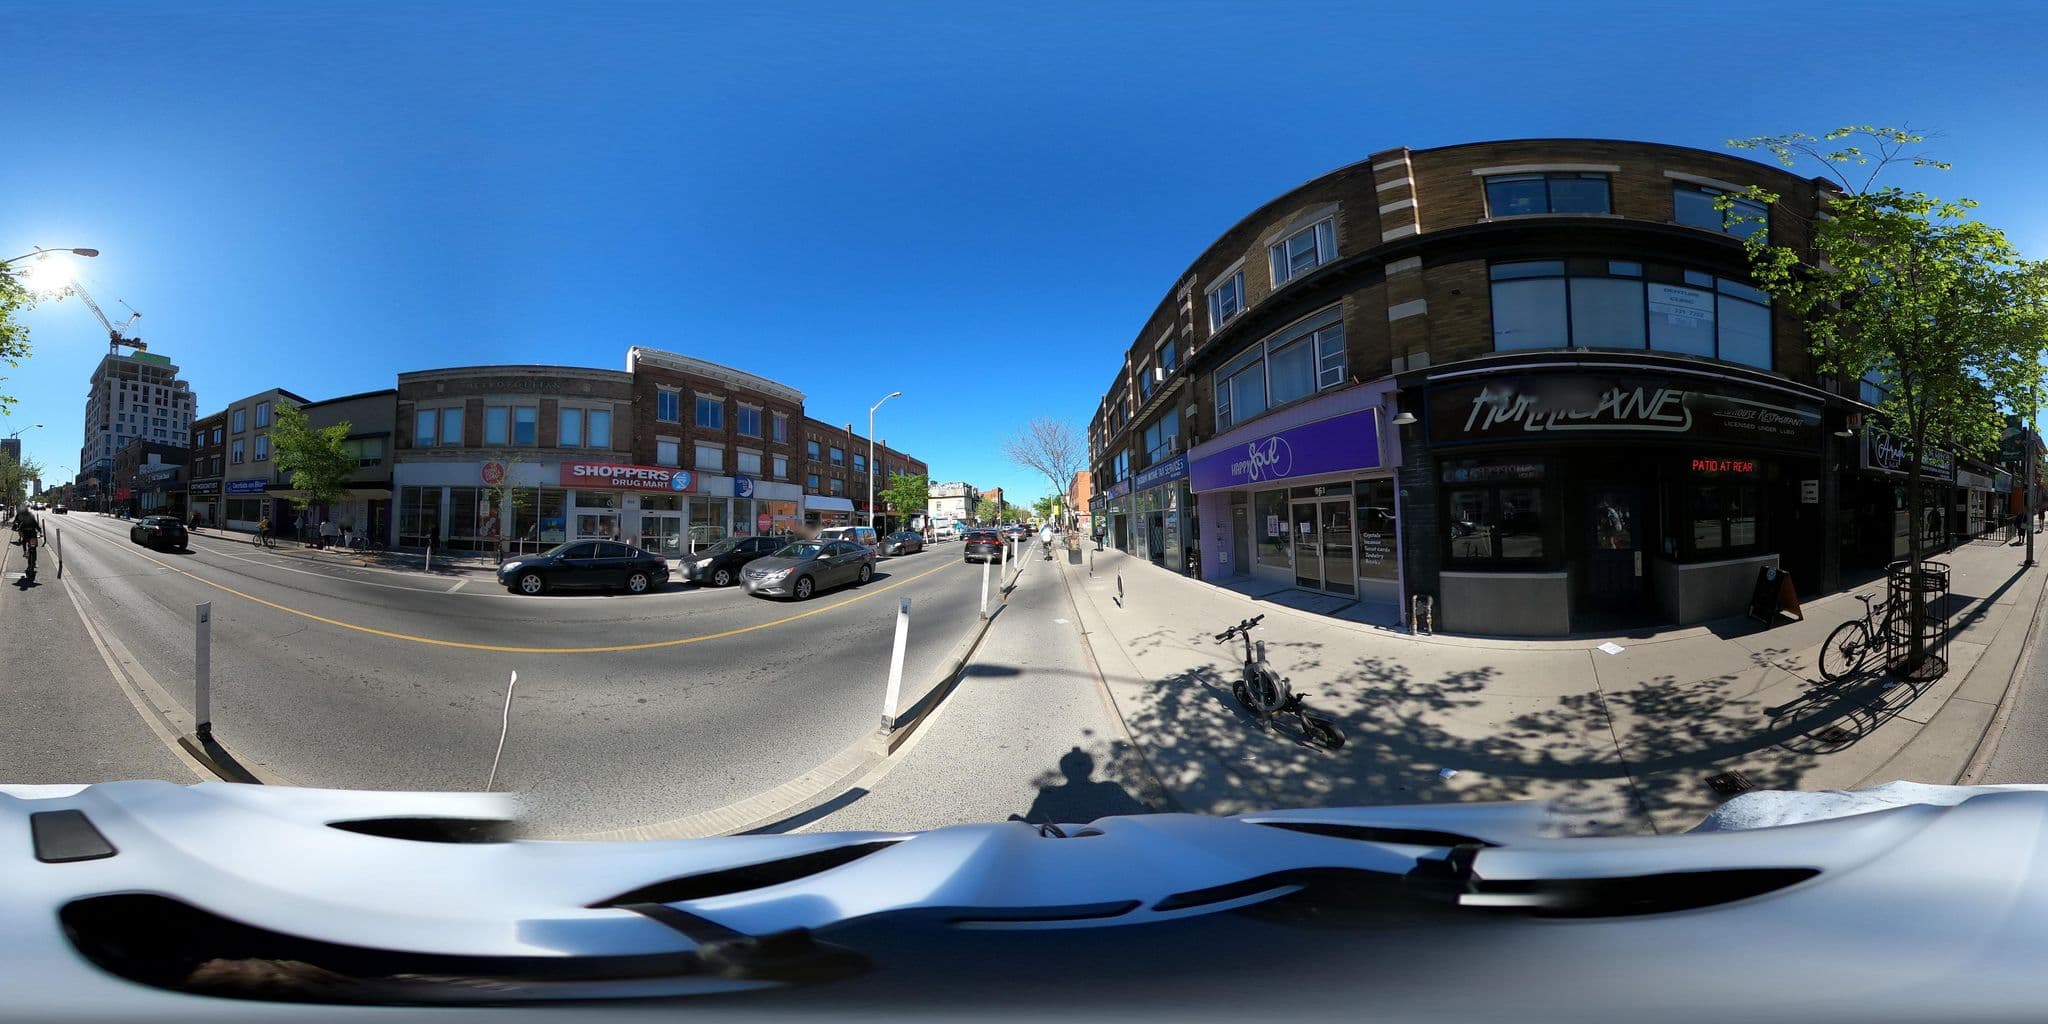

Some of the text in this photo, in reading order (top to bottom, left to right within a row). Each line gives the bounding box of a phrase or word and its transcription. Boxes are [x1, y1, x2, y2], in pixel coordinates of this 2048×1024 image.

[1231, 437, 1280, 481] HAPPY Soul
[1692, 459, 1753, 472] PATIO AT REAR
[573, 465, 670, 481] SHOPPERS
[612, 478, 669, 488] DRUG MART
